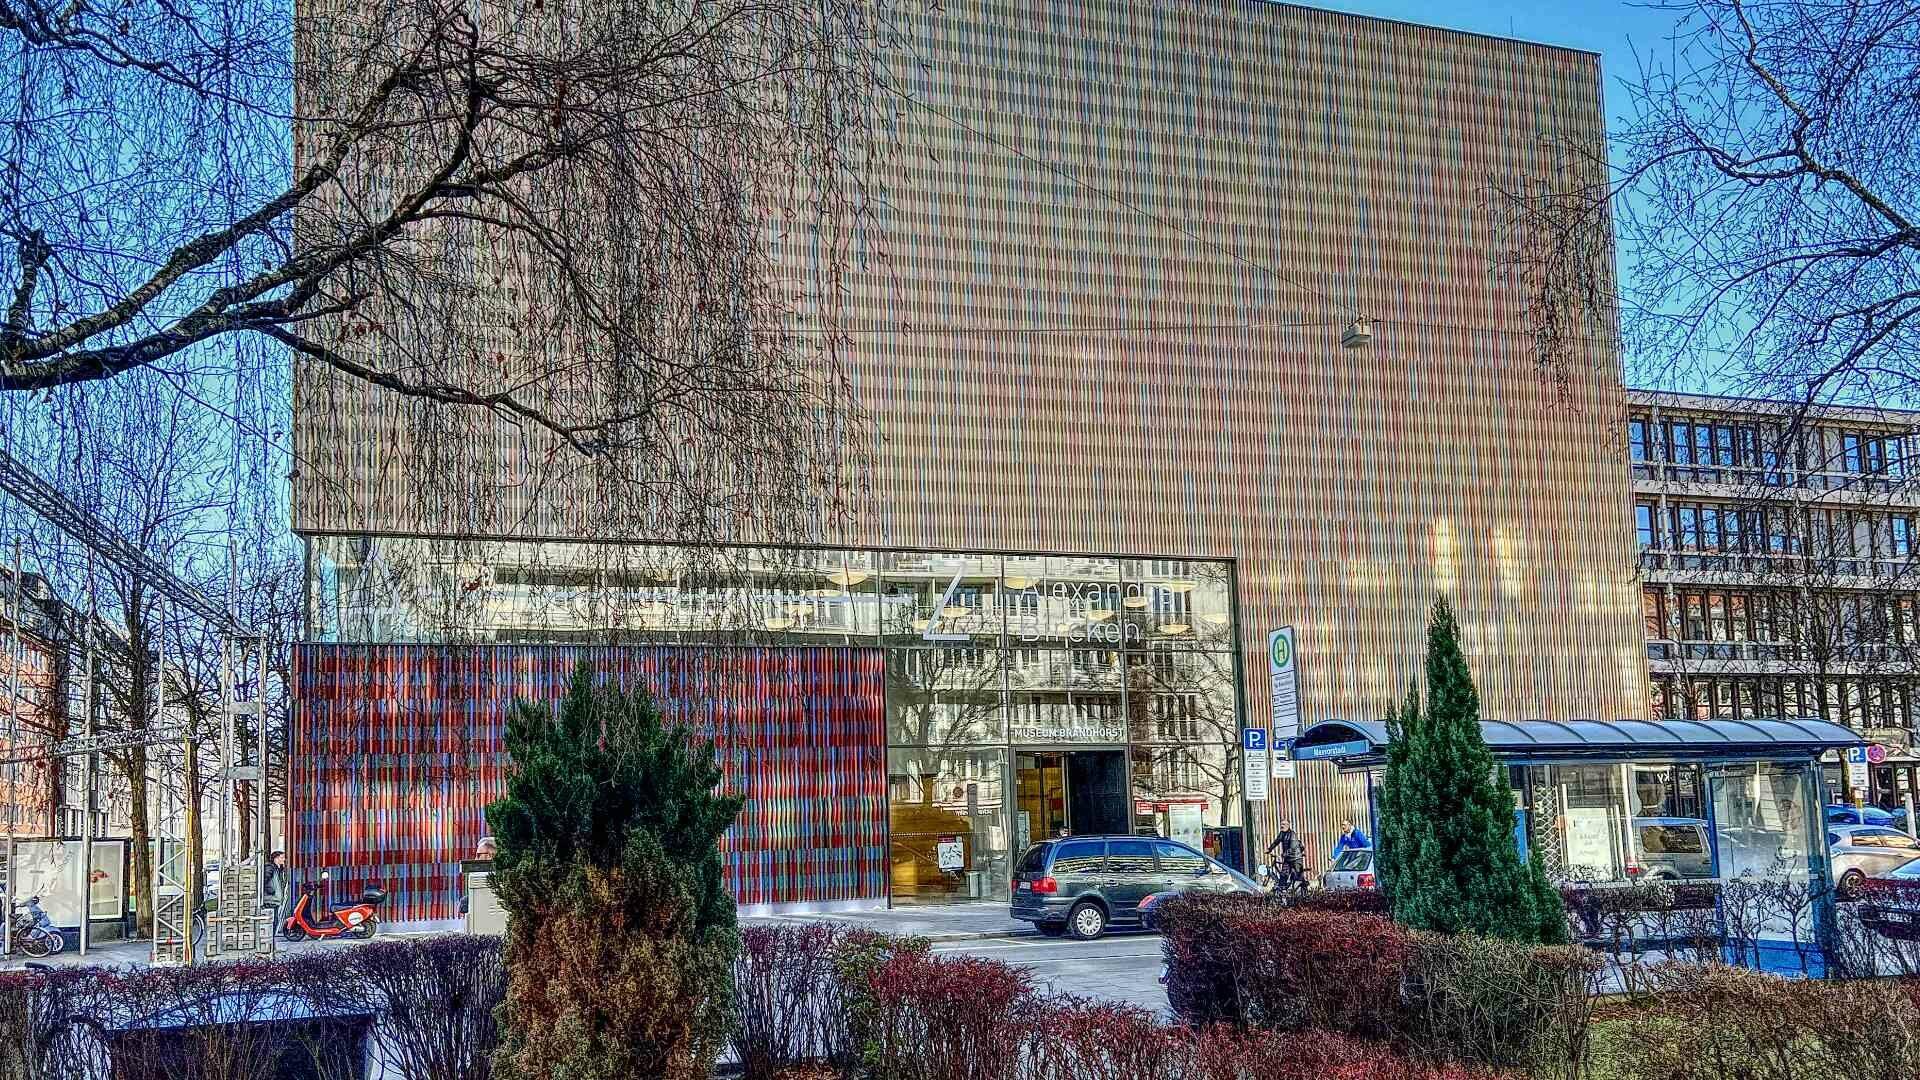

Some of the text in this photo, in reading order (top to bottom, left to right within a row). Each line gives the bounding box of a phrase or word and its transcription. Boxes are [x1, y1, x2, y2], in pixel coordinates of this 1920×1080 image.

[1020, 576, 1175, 606] Alexanda
[1277, 641, 1285, 660] H
[1014, 727, 1125, 738] MUSEUM BRANDHORST
[1249, 731, 1261, 748] P
[1850, 747, 1860, 762] P
